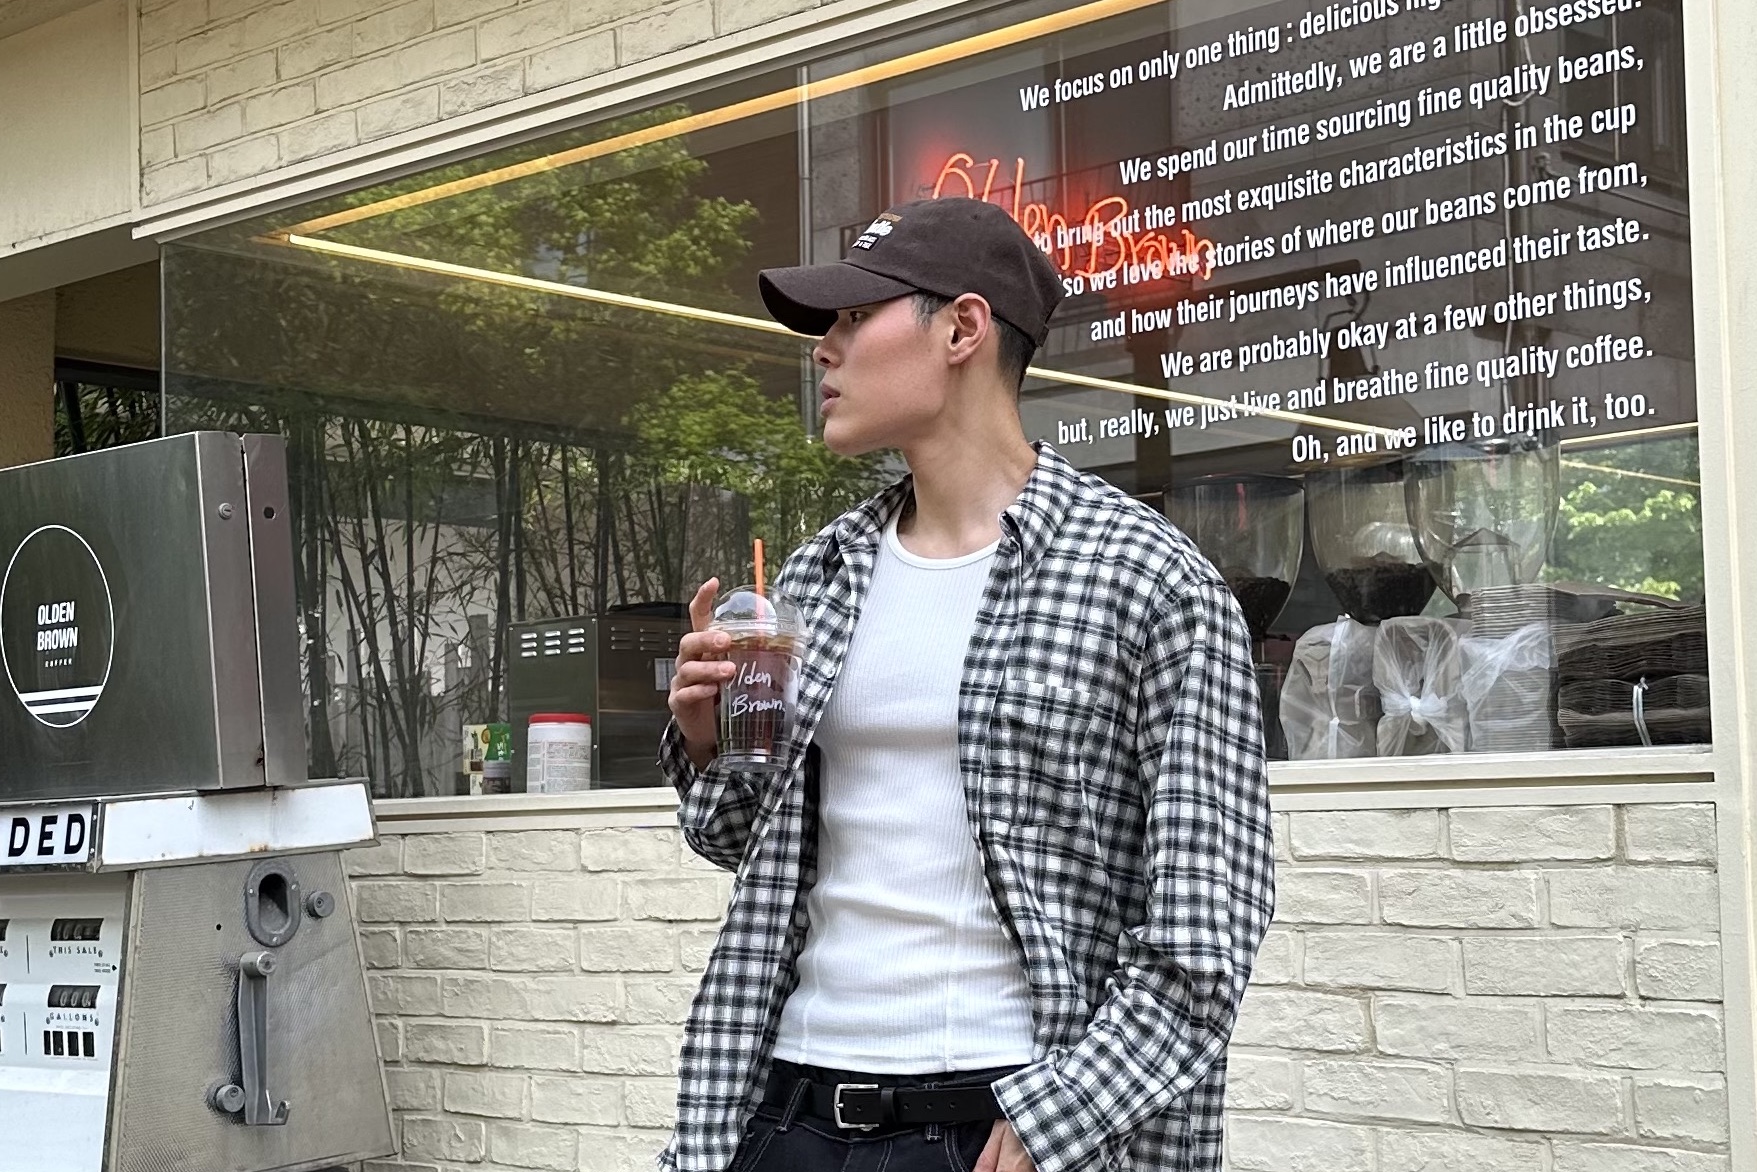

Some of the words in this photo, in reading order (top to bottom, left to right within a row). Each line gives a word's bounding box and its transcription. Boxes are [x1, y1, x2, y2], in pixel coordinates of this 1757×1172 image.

[1019, 84, 1050, 112] We
[1054, 72, 1105, 103] focus
[1109, 65, 1133, 89] on
[1138, 49, 1180, 81] only
[1185, 41, 1223, 69] one
[1227, 26, 1280, 58] thing
[1299, 0, 1399, 39] delicious
[1222, 60, 1343, 111] Admittedly,
[1349, 52, 1382, 79] we
[1388, 41, 1426, 70] are
[1432, 36, 1447, 59] a
[1454, 17, 1507, 53] little
[1119, 157, 1152, 185] We
[1156, 139, 1217, 181] spend
[1223, 135, 1258, 162] our
[1261, 123, 1310, 153] time
[1316, 99, 1411, 141] sourcing
[1417, 87, 1462, 117] fine
[1469, 63, 1551, 110] quality
[1558, 45, 1644, 84] beans,
[1057, 221, 1105, 249] bring
[1110, 209, 1141, 238] out
[1144, 204, 1176, 230] the
[1181, 189, 1232, 223] most
[1237, 169, 1333, 211] exquisite
[1339, 131, 1507, 189] characteristics
[1514, 122, 1537, 151] in
[1543, 114, 1583, 144] the
[1591, 103, 1636, 134] cup
[1057, 274, 1084, 298] so
[1089, 268, 1117, 292] we
[1123, 258, 1163, 286] love
[1205, 235, 1275, 271] stories
[1281, 225, 1302, 254] of
[1306, 216, 1375, 249] where
[1381, 206, 1419, 234] our
[1425, 191, 1496, 225] beans
[1503, 176, 1571, 210] come
[1577, 162, 1647, 195] from,
[1090, 311, 1126, 341] and
[1131, 308, 1172, 334] how
[1176, 294, 1224, 326] their
[1229, 280, 1319, 323] journeys
[1325, 269, 1378, 299] have
[1385, 238, 1506, 288] influenced
[1512, 228, 1571, 264] their
[1576, 217, 1649, 252] taste.
[1160, 351, 1194, 379] We
[1199, 348, 1233, 373] are
[1238, 327, 1331, 372] probably
[1337, 321, 1389, 350] okay
[1395, 311, 1418, 341] at
[1423, 313, 1437, 336] a
[1443, 304, 1487, 332] few
[1493, 291, 1558, 324] other
[1562, 277, 1651, 312] things,
[1057, 417, 1094, 445] but,
[1099, 408, 1159, 439] really,
[1165, 405, 1195, 429] we
[1200, 394, 1238, 430] just
[1243, 390, 1281, 417] live
[1287, 379, 1326, 411] and
[1333, 368, 1418, 404] breathe
[1424, 360, 1469, 390] fine
[1476, 345, 1559, 388] quality
[1565, 333, 1653, 369] coffee.
[1292, 434, 1329, 464] Oh,
[1336, 426, 1377, 457] and
[1384, 426, 1417, 450] we
[1424, 415, 1466, 445] like
[1471, 411, 1495, 438] to
[1502, 400, 1566, 435] drink
[1571, 396, 1597, 428] it,
[1604, 392, 1655, 420] too.
[37, 601, 75, 626] OLDEN
[37, 626, 79, 651] BROWN
[8, 813, 86, 858] DED
